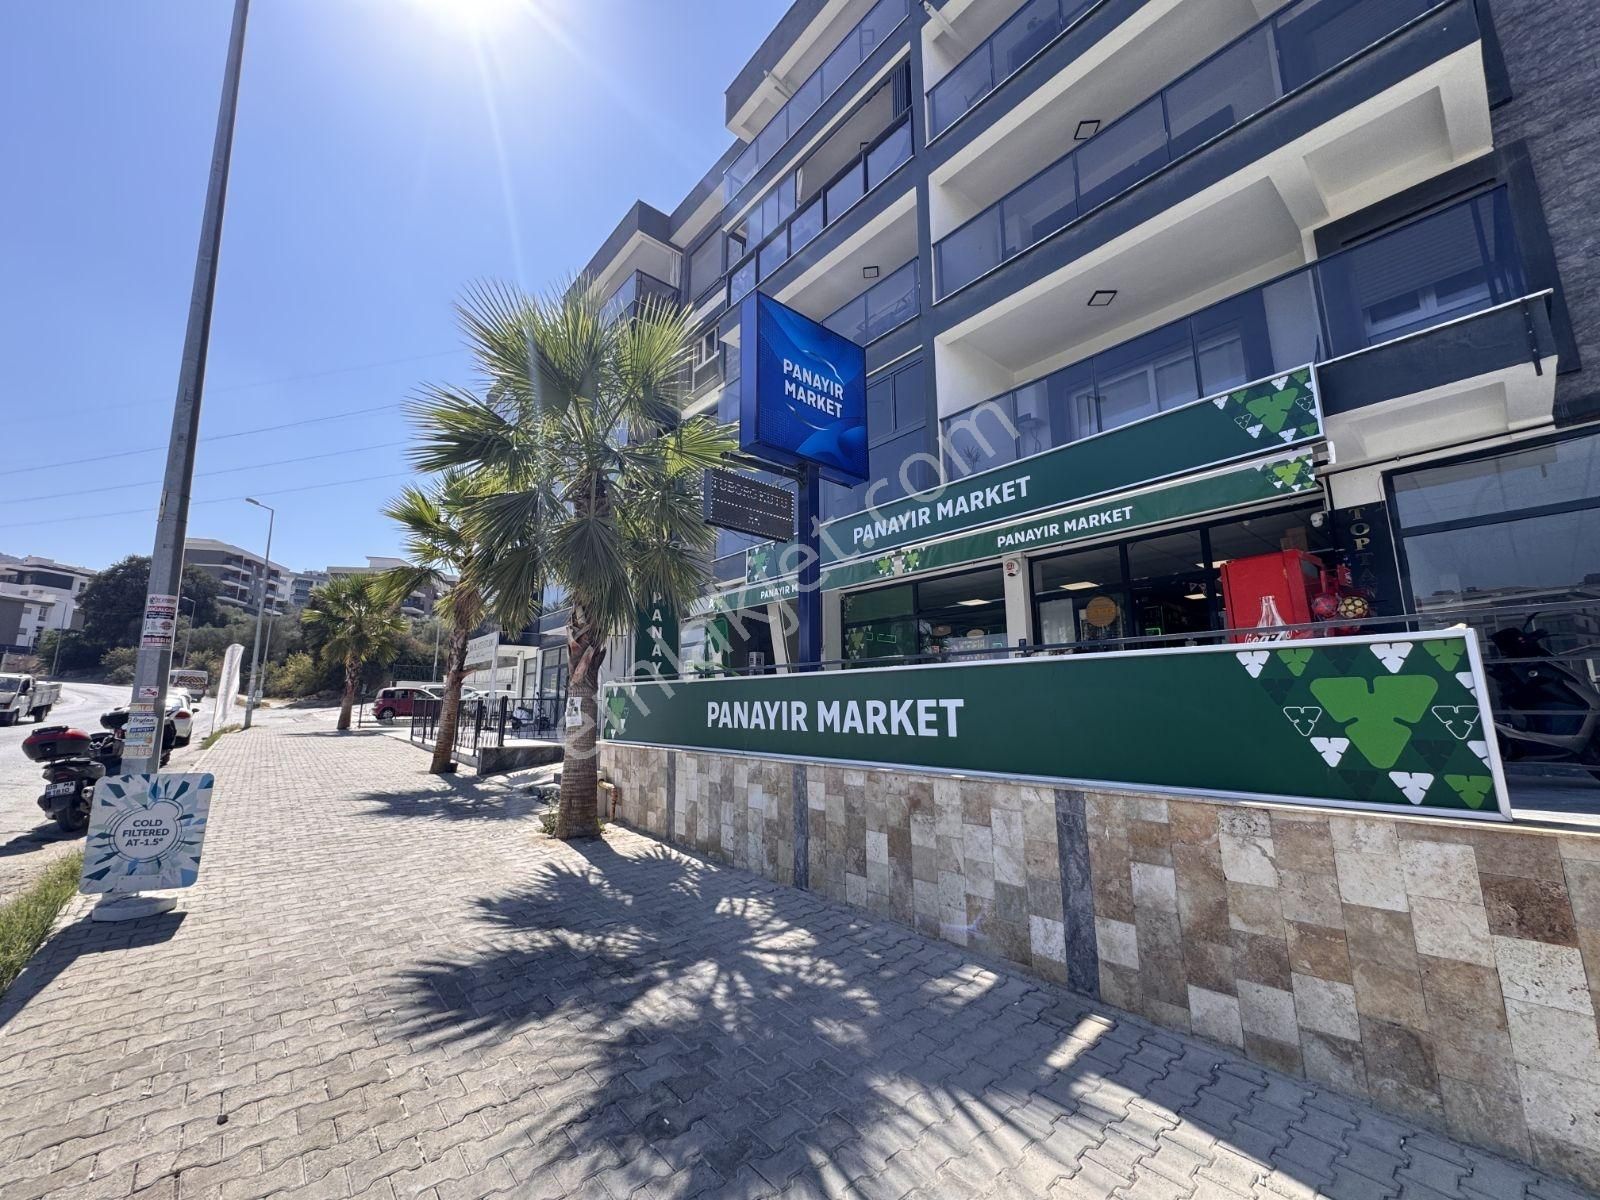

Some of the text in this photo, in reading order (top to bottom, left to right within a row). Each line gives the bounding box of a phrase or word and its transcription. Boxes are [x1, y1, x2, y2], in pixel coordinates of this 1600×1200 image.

[783, 358, 844, 401] PANAYIR
[785, 379, 843, 419] MARKET
[853, 475, 1031, 545] PANAYIR MARKET
[997, 506, 1133, 549] PANAYIR MARKET
[760, 585, 790, 600] PANAYIR
[706, 698, 965, 738] PANAYIR MARKET
[122, 828, 170, 838] FILTERED
[132, 819, 163, 828] COLD
